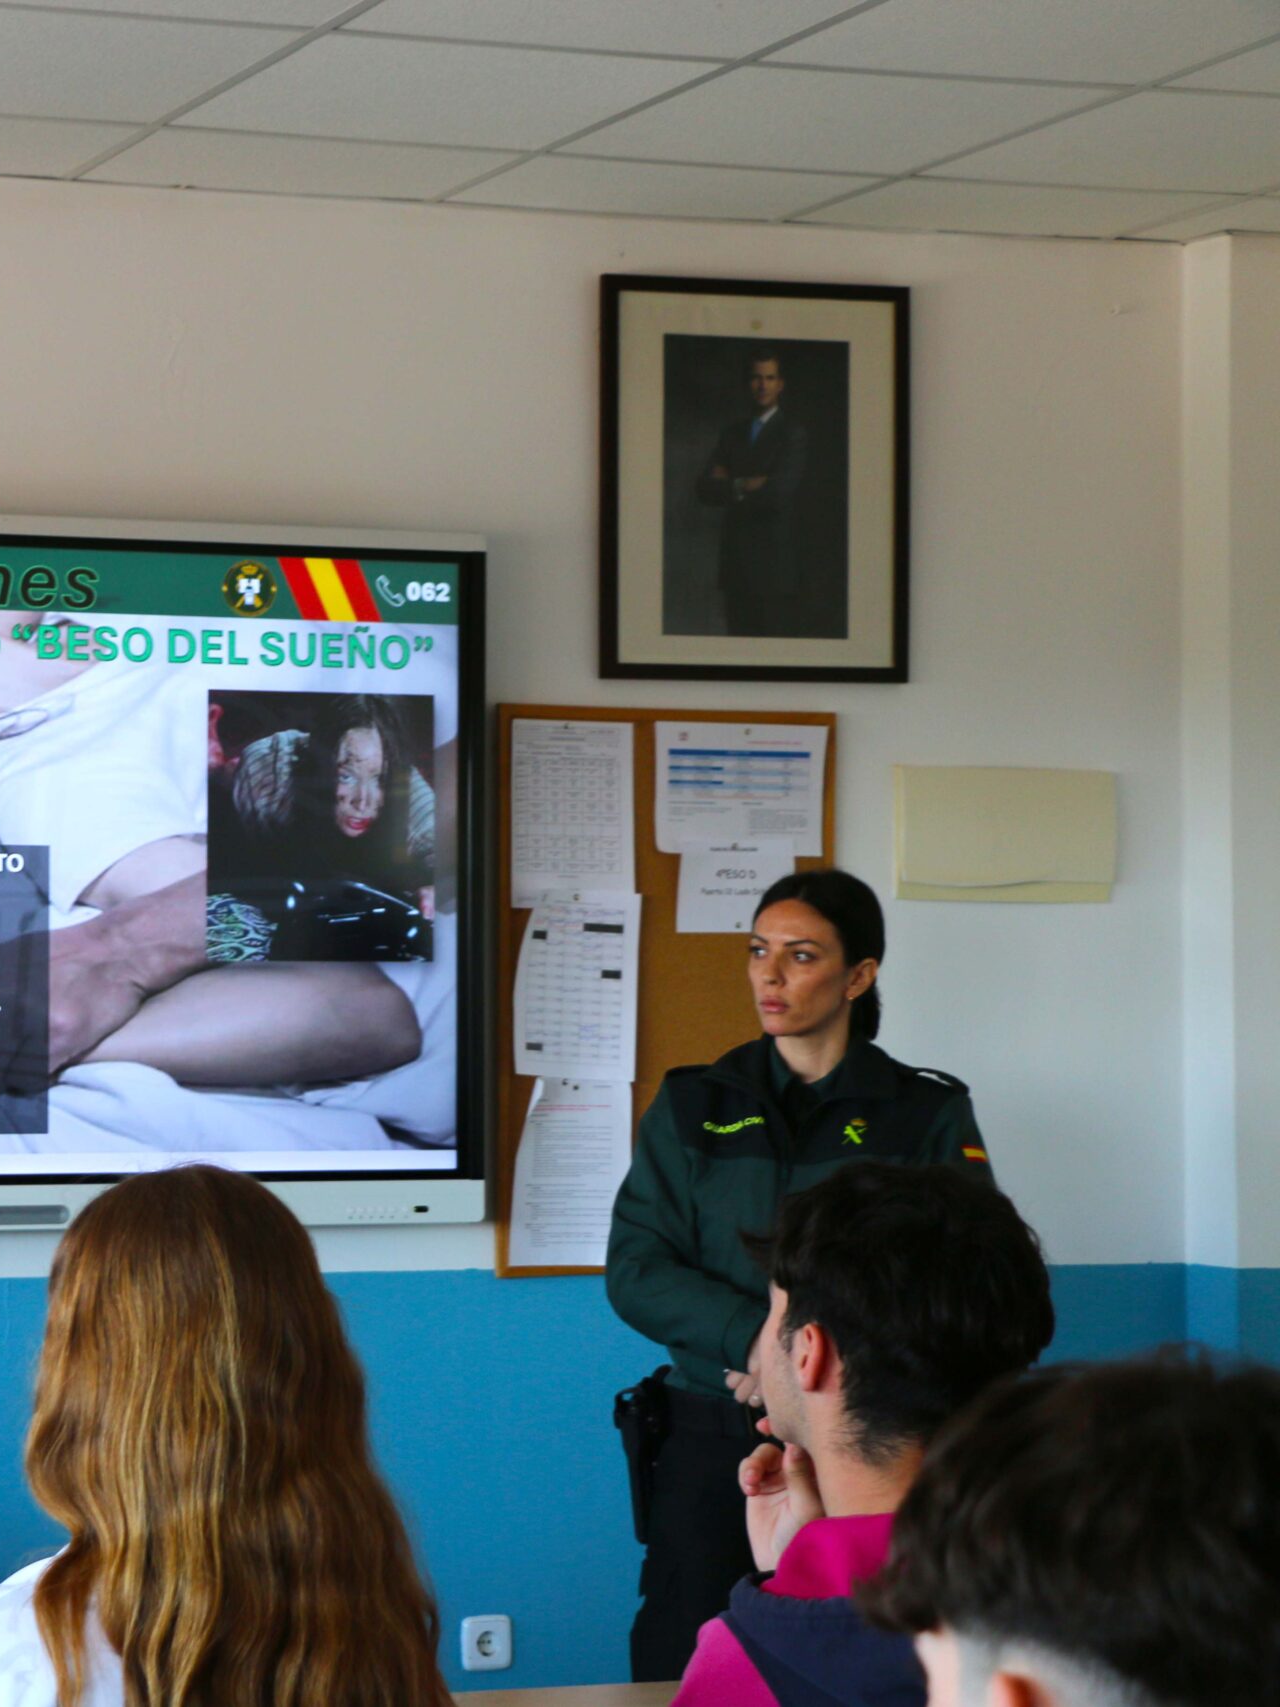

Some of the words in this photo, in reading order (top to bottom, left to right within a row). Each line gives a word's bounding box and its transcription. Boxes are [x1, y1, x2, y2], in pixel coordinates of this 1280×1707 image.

[406, 581, 451, 602] 062
[11, 623, 154, 663] “BESO
[167, 627, 249, 665] DEL
[259, 625, 434, 670] SUEÑO”
